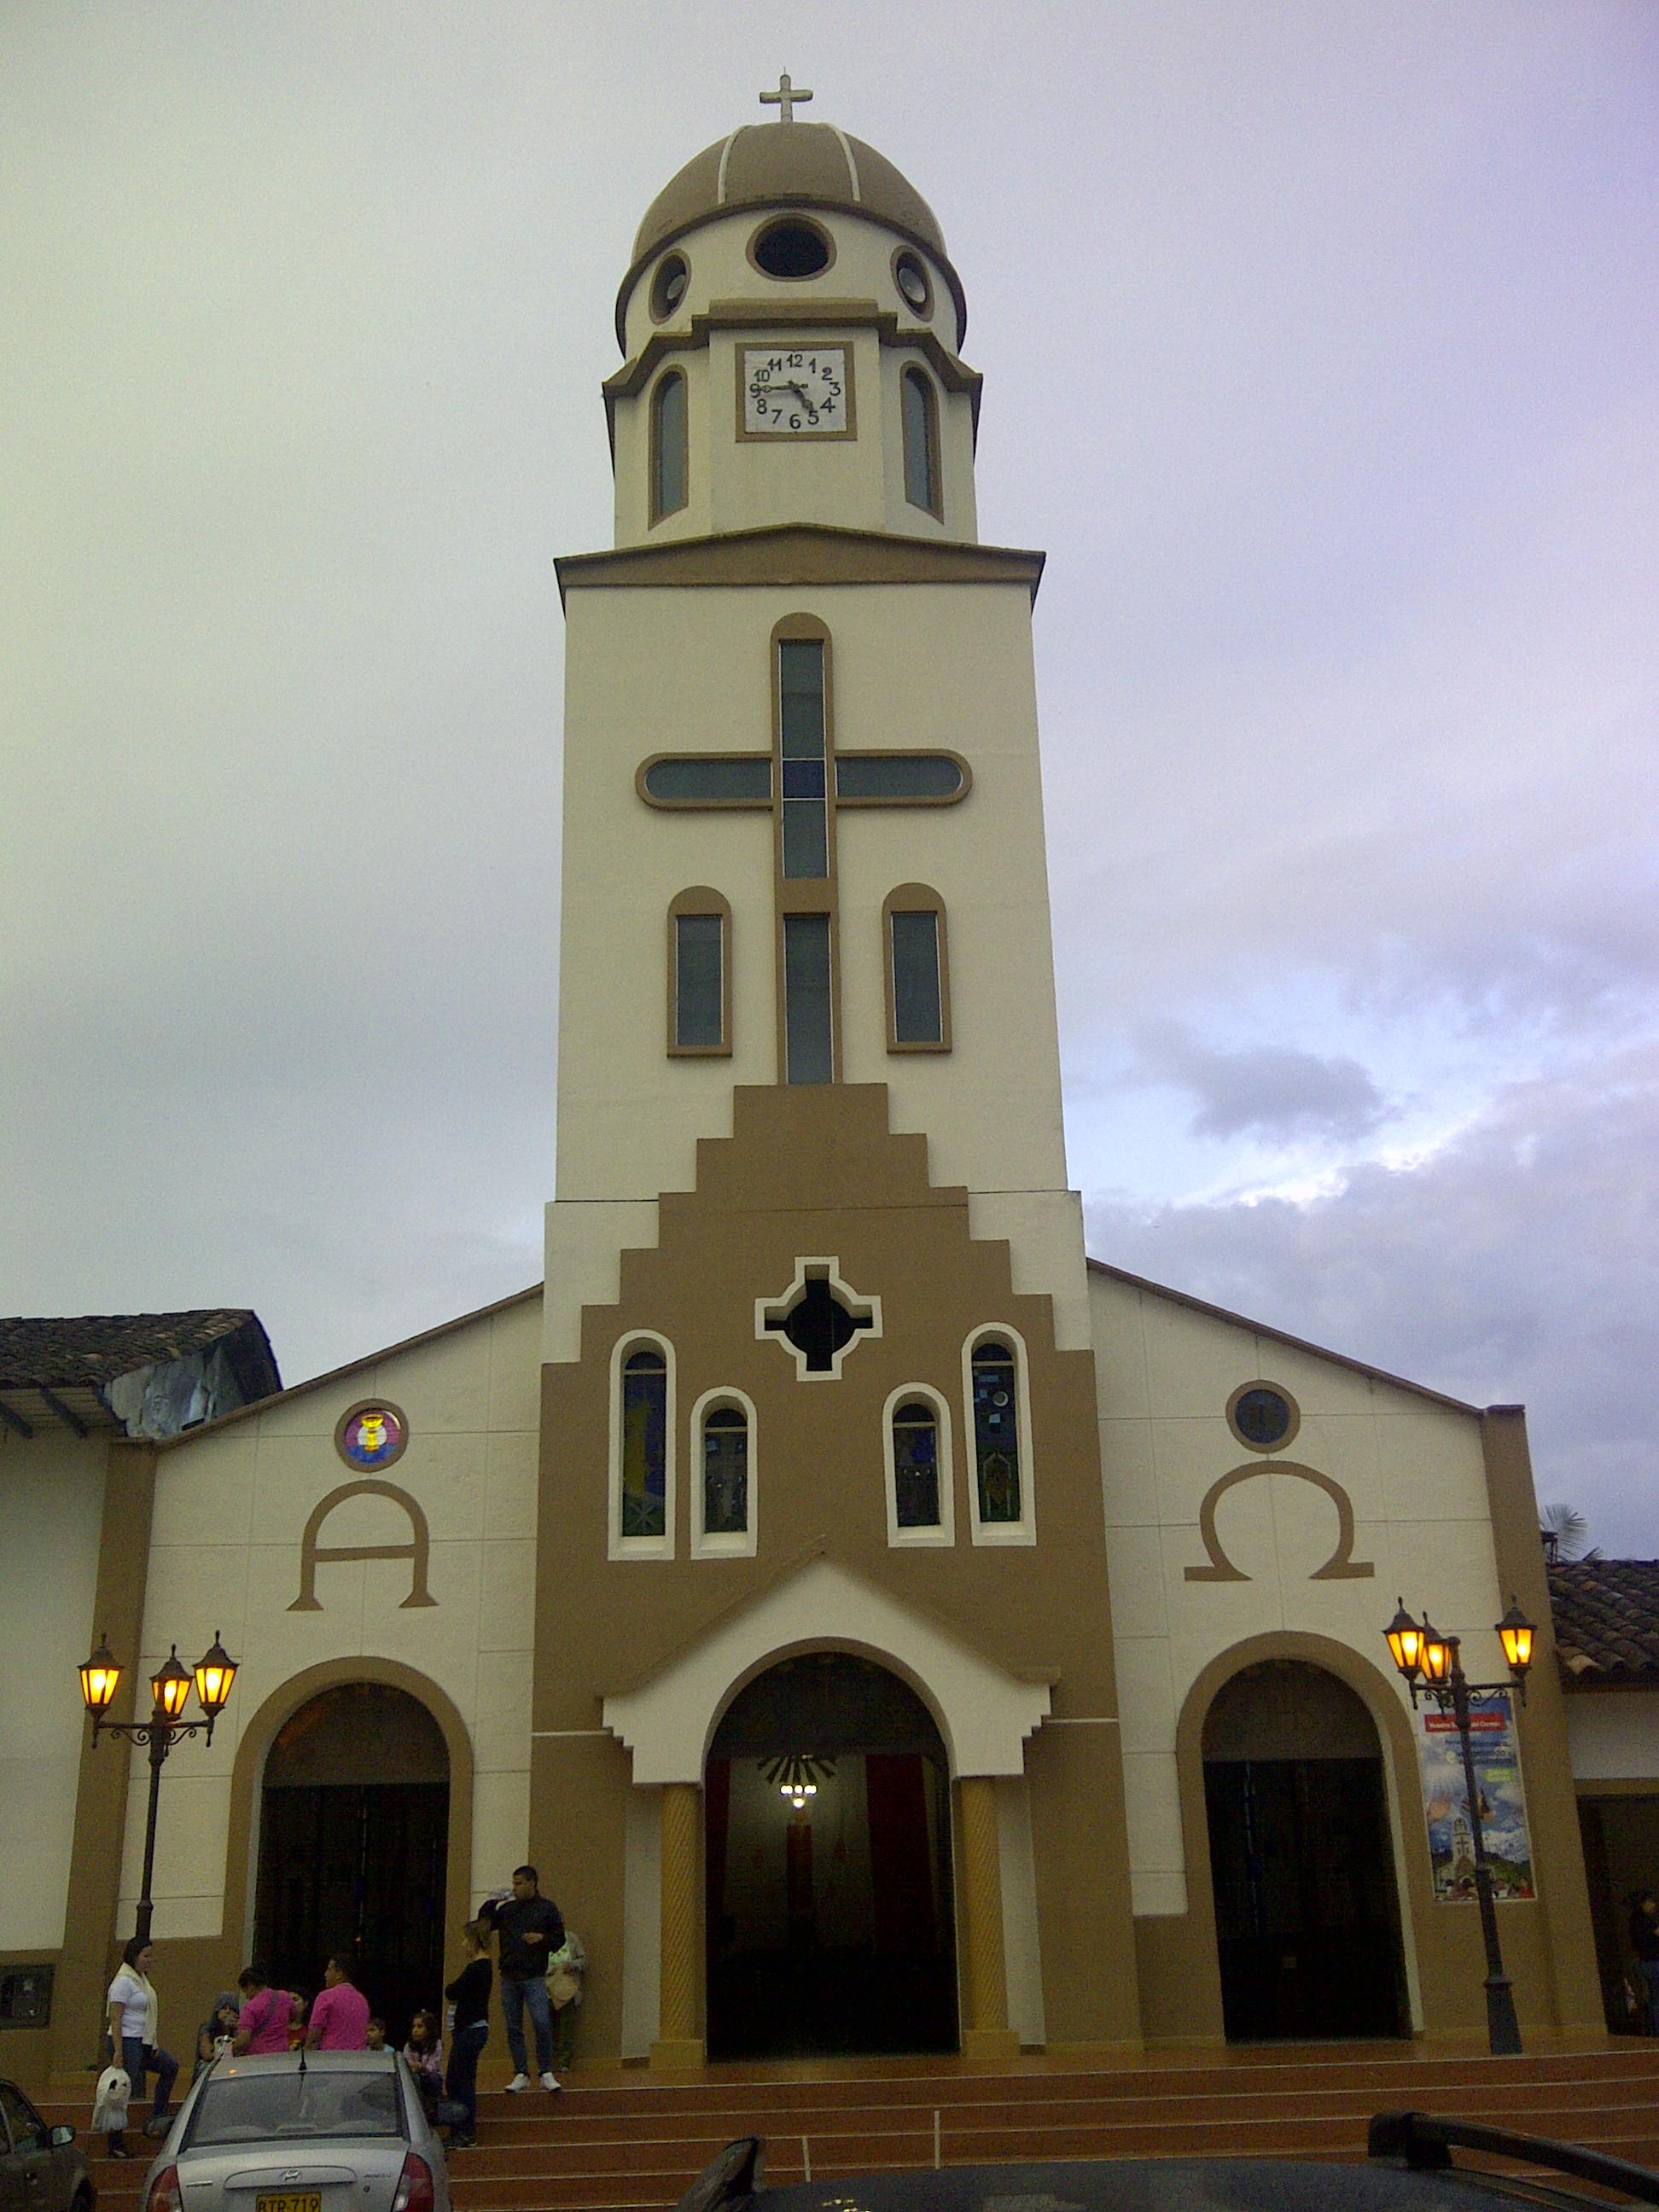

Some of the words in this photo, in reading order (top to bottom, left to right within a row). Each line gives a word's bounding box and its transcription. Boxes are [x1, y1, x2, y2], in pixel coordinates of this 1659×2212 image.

[768, 358, 782, 371] 11
[787, 354, 802, 368] 12
[809, 358, 816, 373] 1
[754, 370, 770, 382] 10
[821, 367, 833, 381] 2
[749, 383, 761, 398] 9
[830, 381, 841, 396] 3
[757, 399, 767, 414] 8
[819, 397, 835, 413] 4
[771, 409, 783, 423] 7
[789, 414, 801, 429] 6
[807, 410, 819, 425] 5
